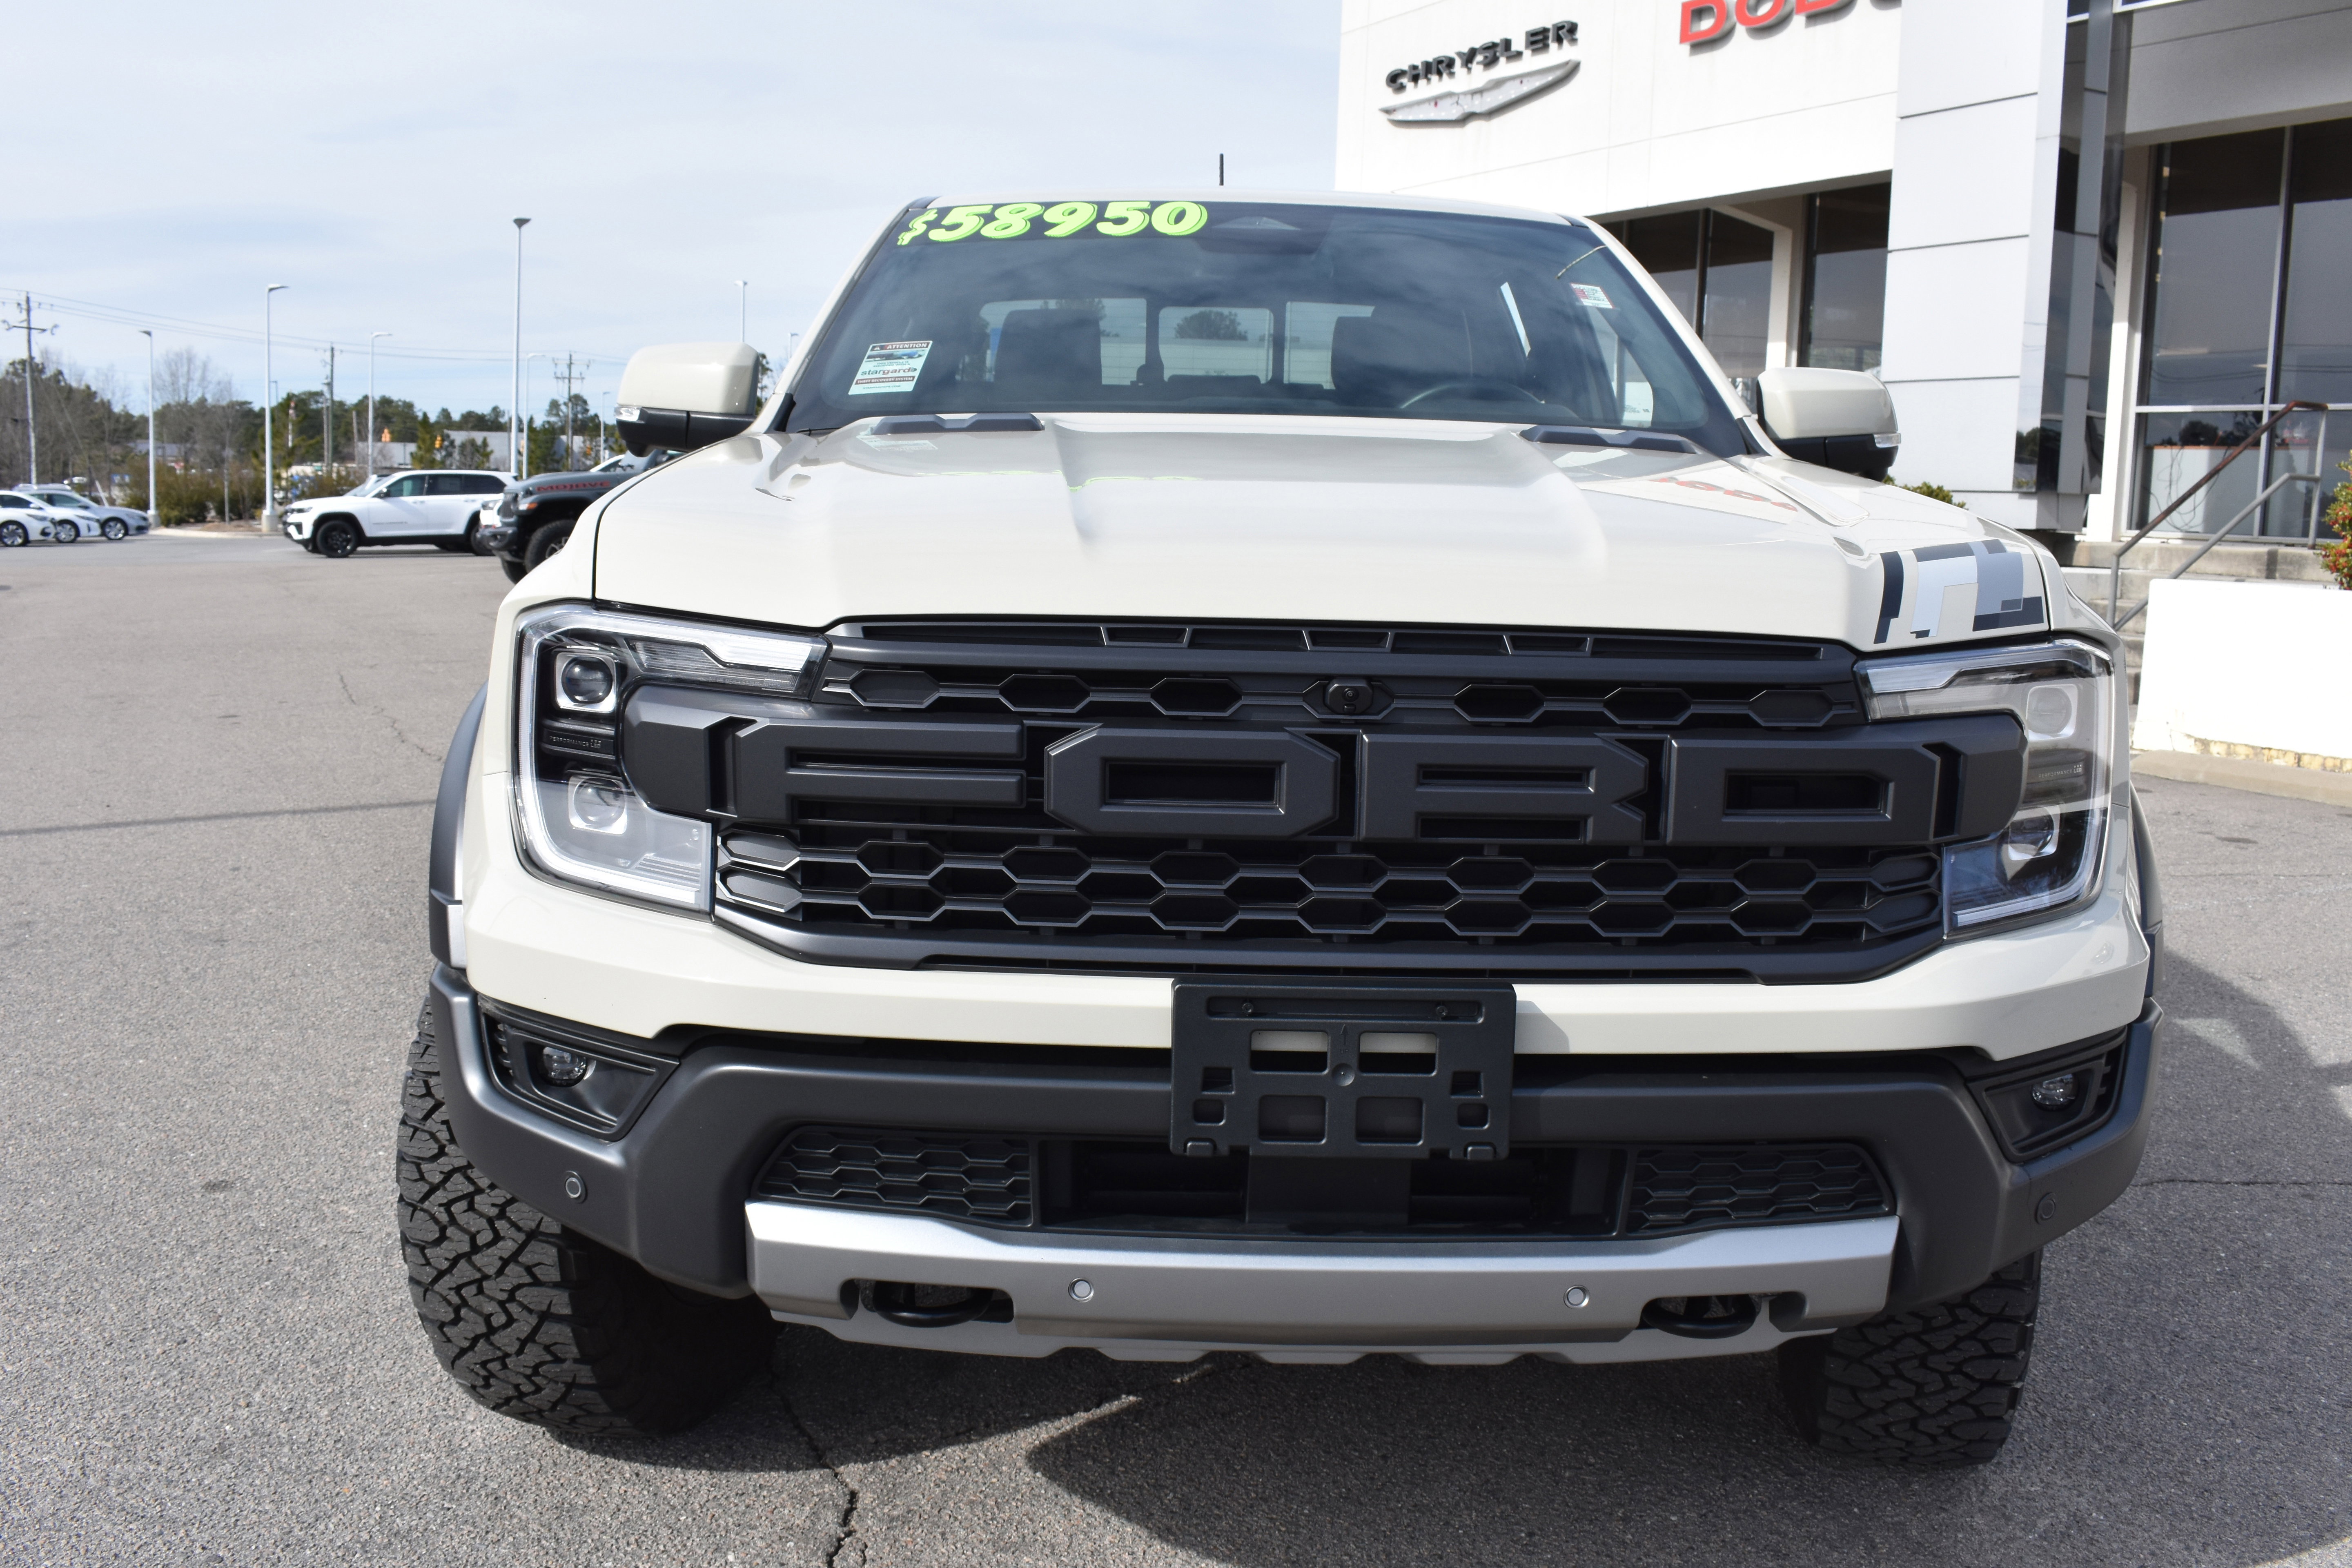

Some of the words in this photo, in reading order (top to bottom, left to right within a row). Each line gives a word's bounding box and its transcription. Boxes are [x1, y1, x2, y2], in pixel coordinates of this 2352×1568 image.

[1386, 20, 1578, 91] CHRYSLER
[897, 201, 1207, 245] $58950
[861, 367, 911, 375] stargard
[536, 481, 611, 492] MOJAVE
[550, 736, 589, 747] PERFORMANCE
[2038, 769, 2073, 778] PERFORMANCE
[735, 720, 1941, 844] FORD
